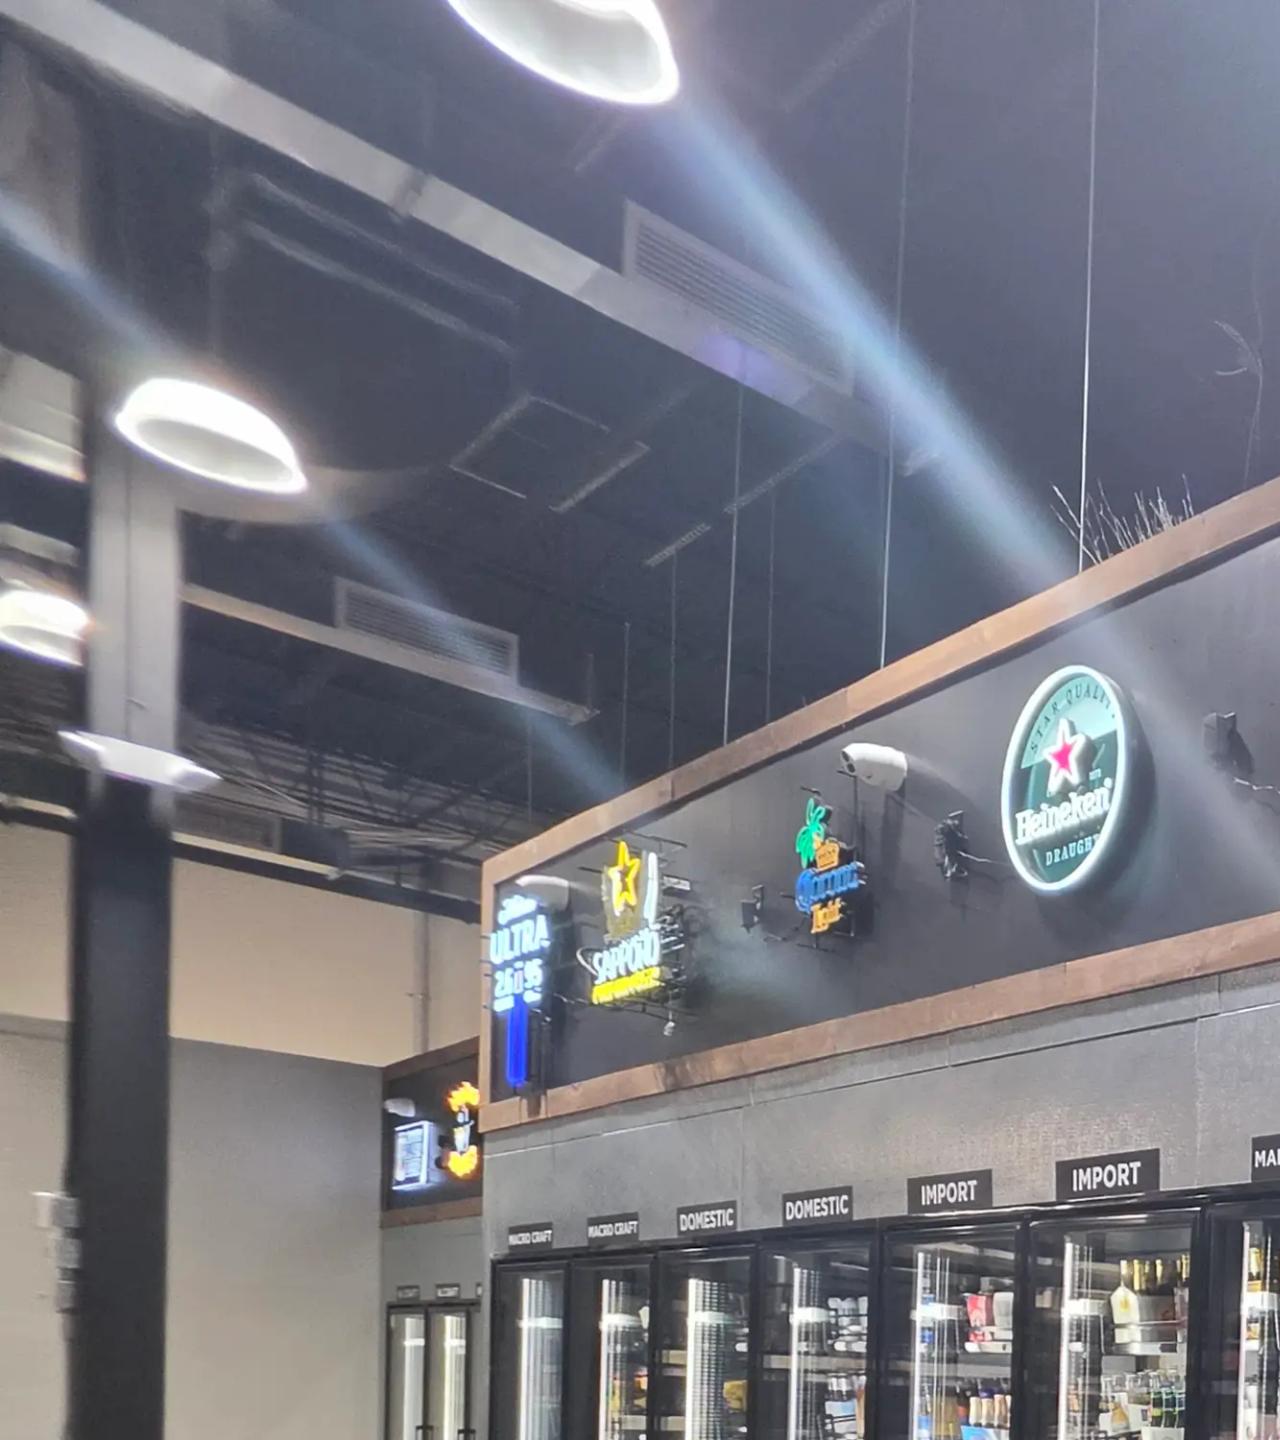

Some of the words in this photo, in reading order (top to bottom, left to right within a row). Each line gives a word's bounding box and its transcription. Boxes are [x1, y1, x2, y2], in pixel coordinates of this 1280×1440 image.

[1015, 779, 1112, 845] Heineken
[490, 914, 551, 965] ULTRA
[1071, 1161, 1141, 1191] IMPORT
[920, 1179, 978, 1205] IMPORT
[679, 1208, 734, 1231] DOMESTIC
[785, 1194, 850, 1220] DOMESTIC
[532, 1230, 552, 1243] CRAFT
[615, 1221, 638, 1234] CRAFT
